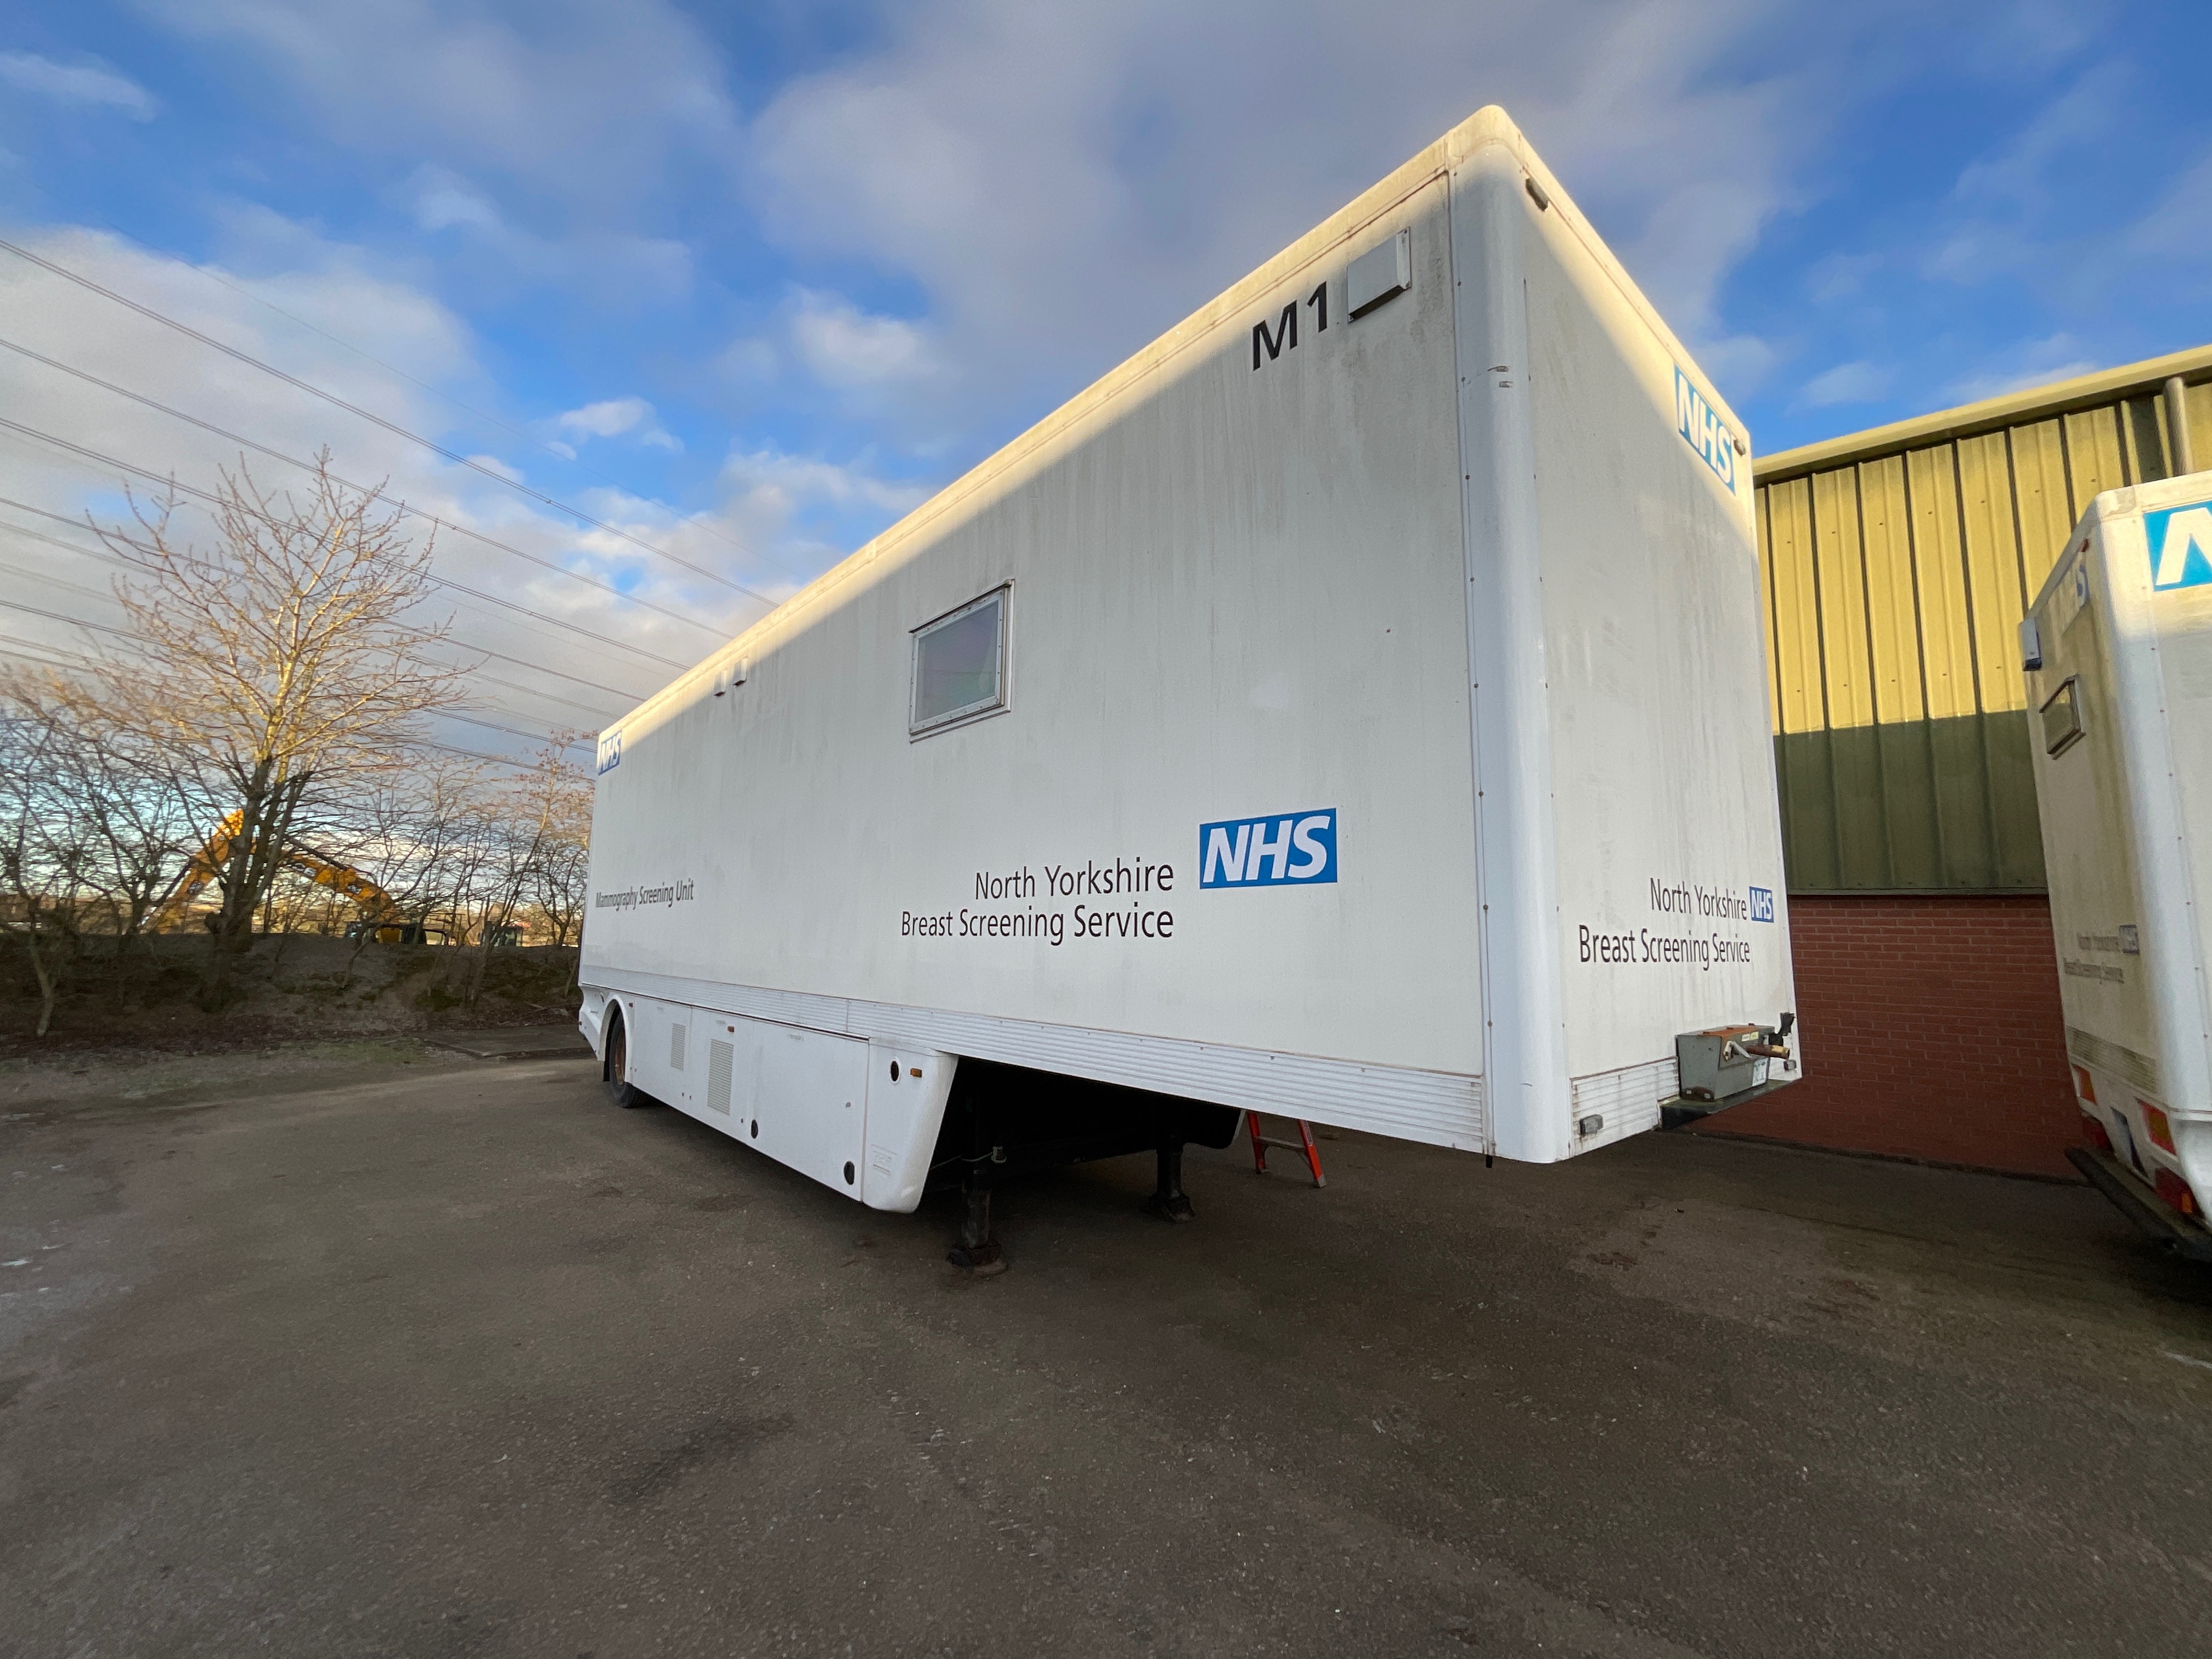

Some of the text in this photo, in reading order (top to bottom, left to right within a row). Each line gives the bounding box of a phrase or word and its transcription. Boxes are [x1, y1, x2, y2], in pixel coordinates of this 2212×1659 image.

[1253, 281, 1327, 371] M1
[1679, 373, 1731, 484] NHS
[598, 732, 622, 774] NHS
[1203, 815, 1331, 883] NHS
[595, 878, 694, 911] Mammography Screening Unit
[976, 856, 1174, 900] North Yorkshire
[1650, 877, 1773, 920] North Yorkshire NHS
[901, 901, 1174, 946] Breast Screening Service
[1579, 924, 1751, 971] Breast Screening Service
